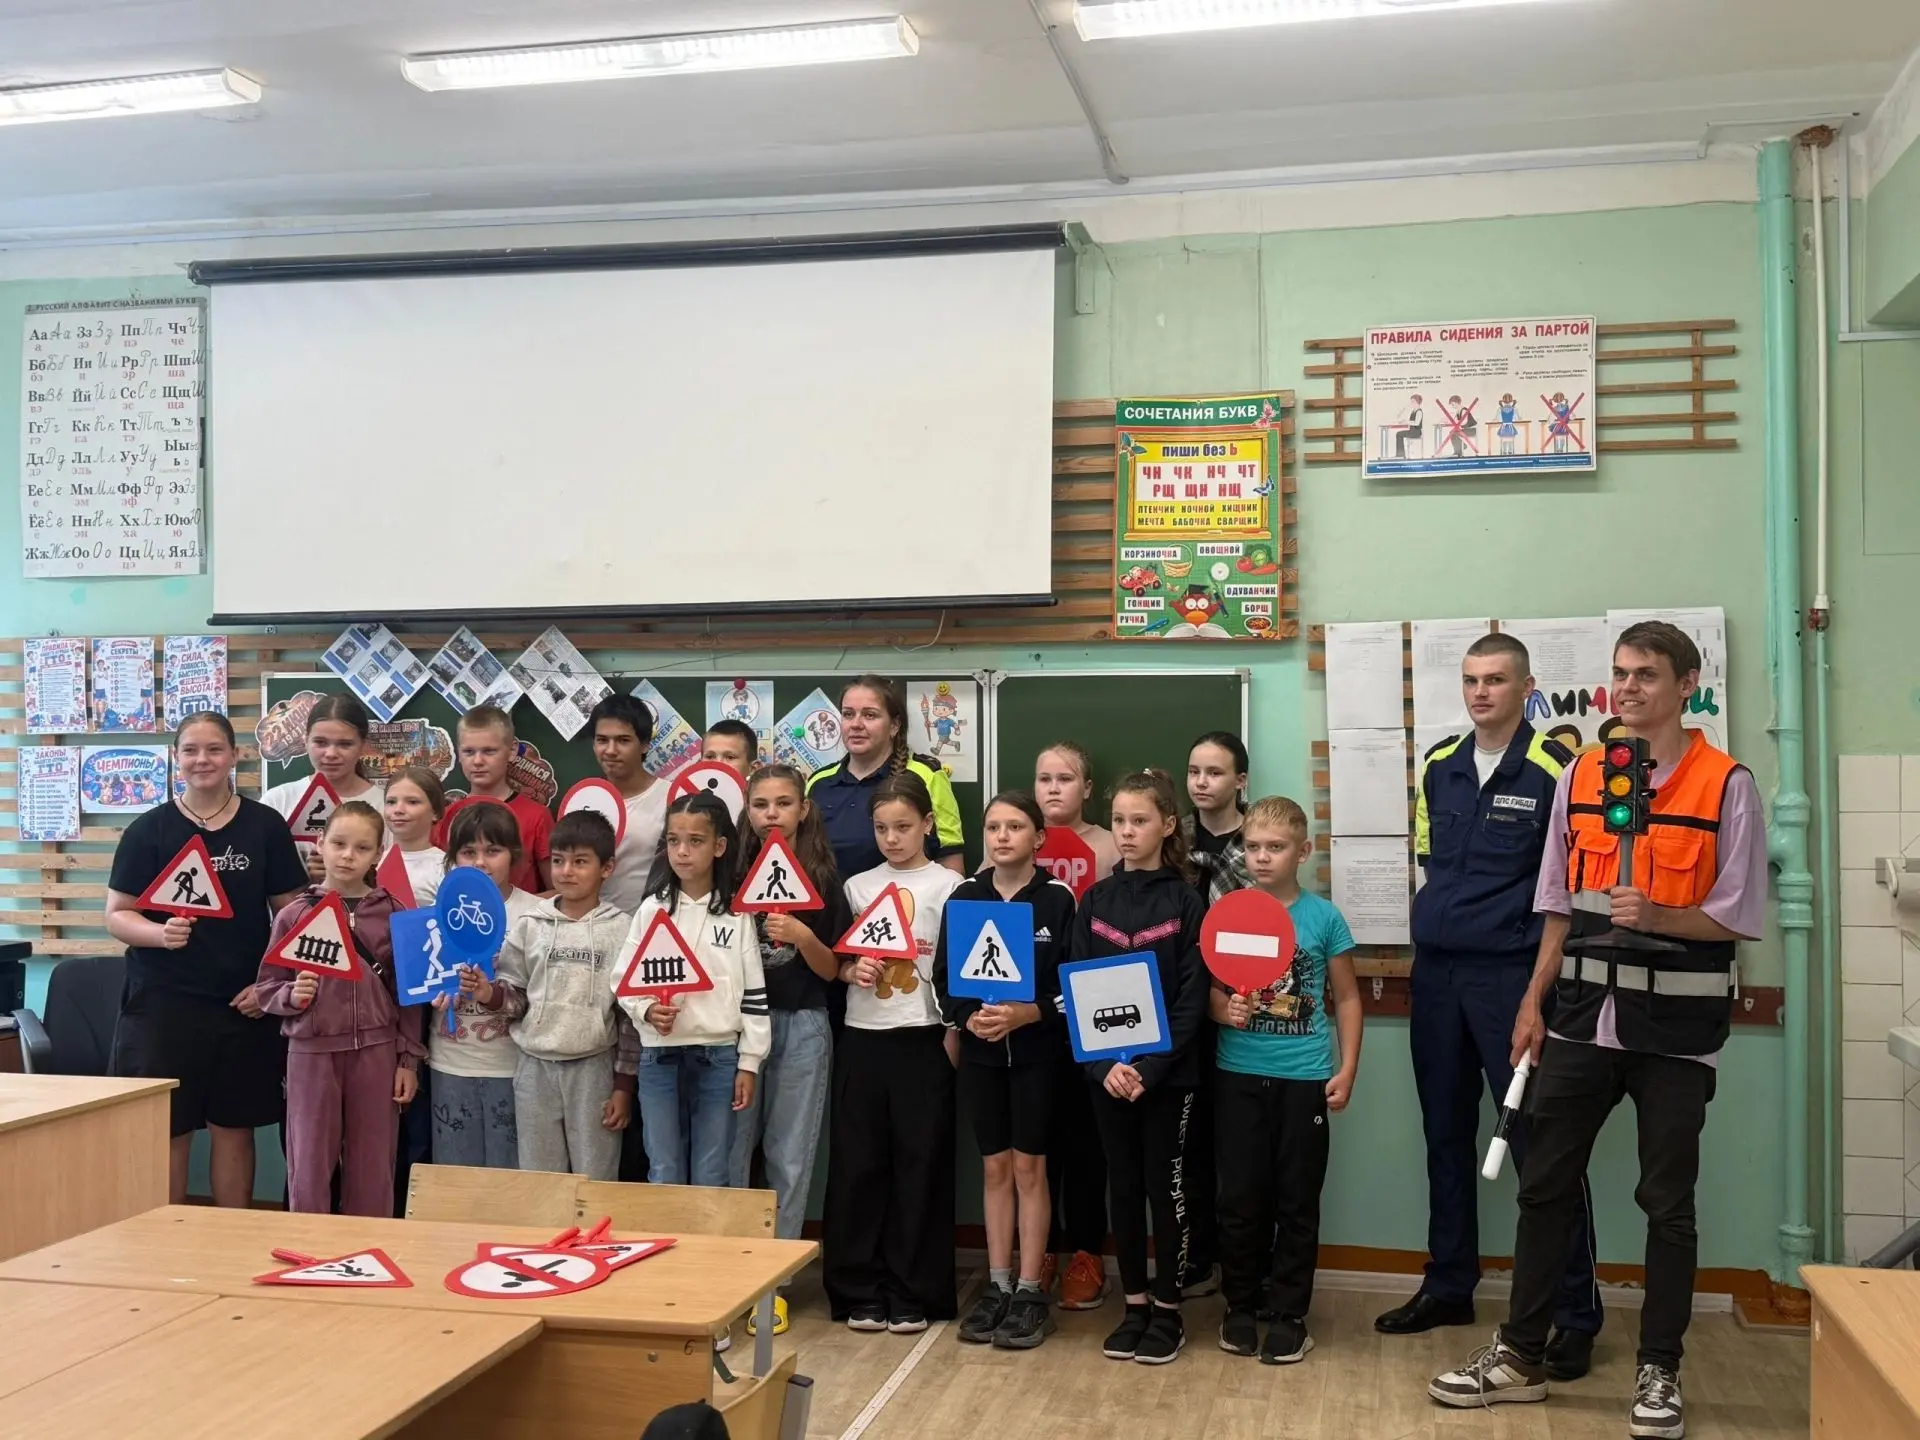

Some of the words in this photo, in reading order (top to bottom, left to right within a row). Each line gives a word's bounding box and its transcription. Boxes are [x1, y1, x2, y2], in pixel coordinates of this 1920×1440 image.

[72, 300, 110, 309] АЛФАВИТ
[120, 298, 173, 307] НАЗВАНИЯМИ
[176, 296, 196, 305] БУКВ
[1371, 330, 1433, 345] ПРАВИЛА
[1440, 326, 1503, 343] СИДЕНИЯ
[1511, 325, 1528, 339] ЗА
[1536, 320, 1590, 337] ПАРТОЙ
[1124, 406, 1214, 420] СОЧЕТАНИЯ
[1219, 405, 1258, 418] БУКВ
[1162, 445, 1200, 457] пиши
[1202, 444, 1226, 456] без
[1142, 466, 1162, 480] ЧН
[1174, 466, 1192, 480] ЧК
[1207, 465, 1226, 478] НЧ
[1238, 464, 1256, 478] ЧТ
[1153, 484, 1174, 499] РЩ
[1185, 484, 1208, 499] ЩН
[1218, 483, 1242, 498] НЩ
[1138, 505, 1175, 514] ПТЕНЧИК
[1181, 504, 1215, 514] НОЧНОЙ
[1222, 504, 1258, 514] ХИЩНИК
[1138, 518, 1164, 526] МЕЧТА
[1172, 517, 1210, 526] БАБОЧКА
[1217, 516, 1258, 526] СВАРЩИК
[1124, 550, 1178, 559] КОРЗИНОЧКА
[1199, 544, 1240, 555] ОВОЩНОЙ
[1226, 586, 1276, 597] ОДУВАНЧИК
[1127, 600, 1161, 608] ГОНЩИК
[1244, 604, 1269, 614] БОРЩ
[1120, 614, 1146, 624] РУЧКА
[44, 654, 66, 666] ГТО
[180, 682, 213, 695] ВЫСОТА!
[183, 700, 208, 714] ГТО
[264, 725, 282, 749] 22
[35, 750, 66, 759] ЗАКОНЫ
[783, 726, 820, 771] БАСКЕТБОЛ
[38, 763, 64, 774] ГТО
[96, 760, 154, 772] ЧЕМПИОНЫ
[714, 925, 734, 946] W
[684, 1340, 696, 1355] 6
